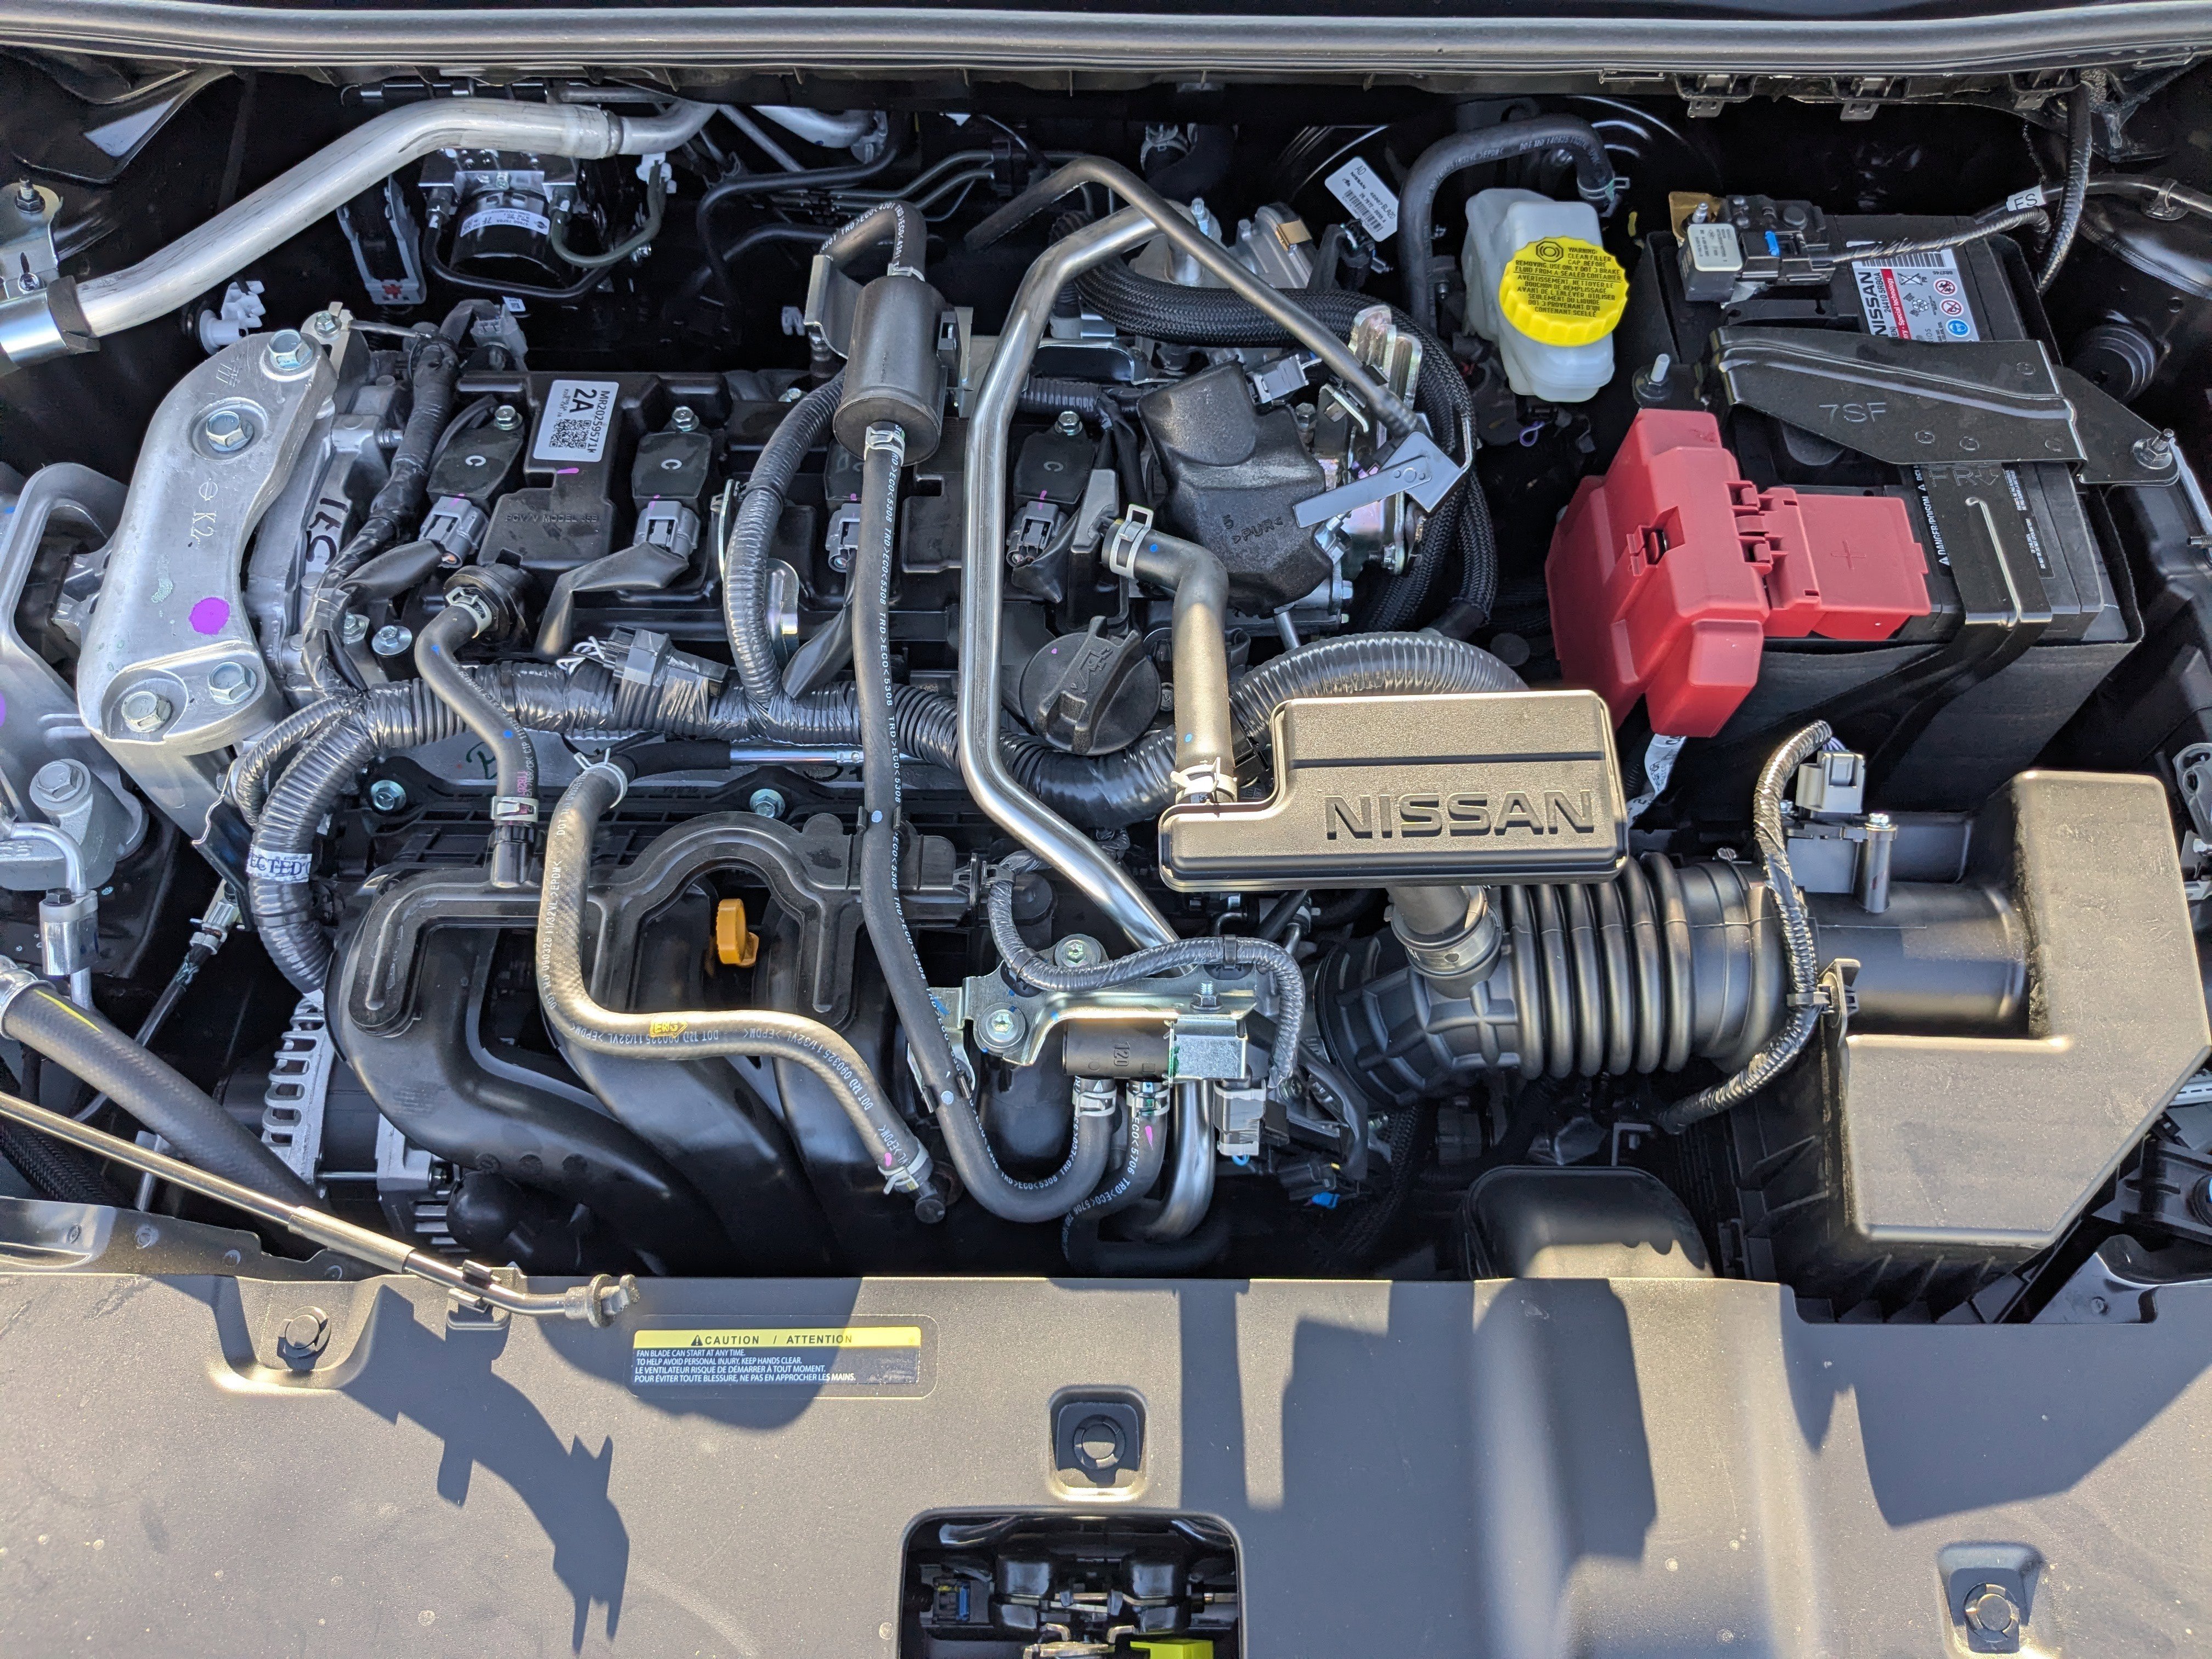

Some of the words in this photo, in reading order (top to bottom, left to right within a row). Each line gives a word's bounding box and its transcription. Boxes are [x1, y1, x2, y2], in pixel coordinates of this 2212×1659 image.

[1355, 165, 1367, 176] AD
[1350, 172, 1367, 190] NISSAN
[2013, 193, 2038, 210] FS
[1528, 293, 1565, 302] SEULEMENT
[1576, 297, 1600, 306] LIQUIDE
[1563, 285, 1607, 294] REMPLISSAGE
[1887, 277, 1898, 306] technology
[1534, 306, 1571, 315] CONTENANT
[1547, 301, 1584, 310] PROVENANT
[1858, 272, 1889, 337] NISSAN
[1880, 295, 1892, 314] 24410
[1894, 306, 1905, 326] Special
[569, 388, 597, 413] 2A
[1819, 403, 1887, 424] 7SF
[1928, 466, 1977, 487] FR
[885, 452, 899, 523] RD>ECO<5308
[190, 510, 217, 538] K2
[505, 514, 538, 523] PCV/V
[542, 514, 578, 523] MODEL
[1922, 495, 1947, 555] DANGER/POISON
[1232, 517, 1284, 545] >PUR<
[522, 742, 532, 754] CIP
[1324, 789, 1595, 838] NISSAN
[556, 814, 568, 836] DOT
[890, 832, 899, 890] >ECO<5308
[549, 861, 563, 898] >EPDM<
[545, 899, 558, 934] 11/32VL
[541, 937, 554, 973] 090325
[543, 989, 558, 1010] DOT
[570, 1022, 604, 1042] >EPDM<
[653, 1021, 679, 1034] ENG
[702, 1030, 719, 1041] DOT
[743, 1028, 782, 1040] >EPDM<
[607, 1033, 643, 1045] 11/32VL
[786, 1030, 824, 1053] 11/32VL
[822, 1048, 853, 1080] 090325
[1113, 1040, 1130, 1069] 120
[857, 1093, 874, 1111] DOT
[1127, 1116, 1140, 1176] ECO<5706
[705, 1335, 759, 1345] CAUTION
[773, 1335, 777, 1344] /
[786, 1335, 852, 1344] ATTENTION
[692, 1366, 717, 1374] RISQUE
[732, 1364, 766, 1373] DÉMARRER
[767, 1364, 774, 1373] À
[718, 1357, 741, 1365] INJURY,
[656, 1373, 679, 1383] ÉVITER
[703, 1374, 738, 1383] BLESSURE,
